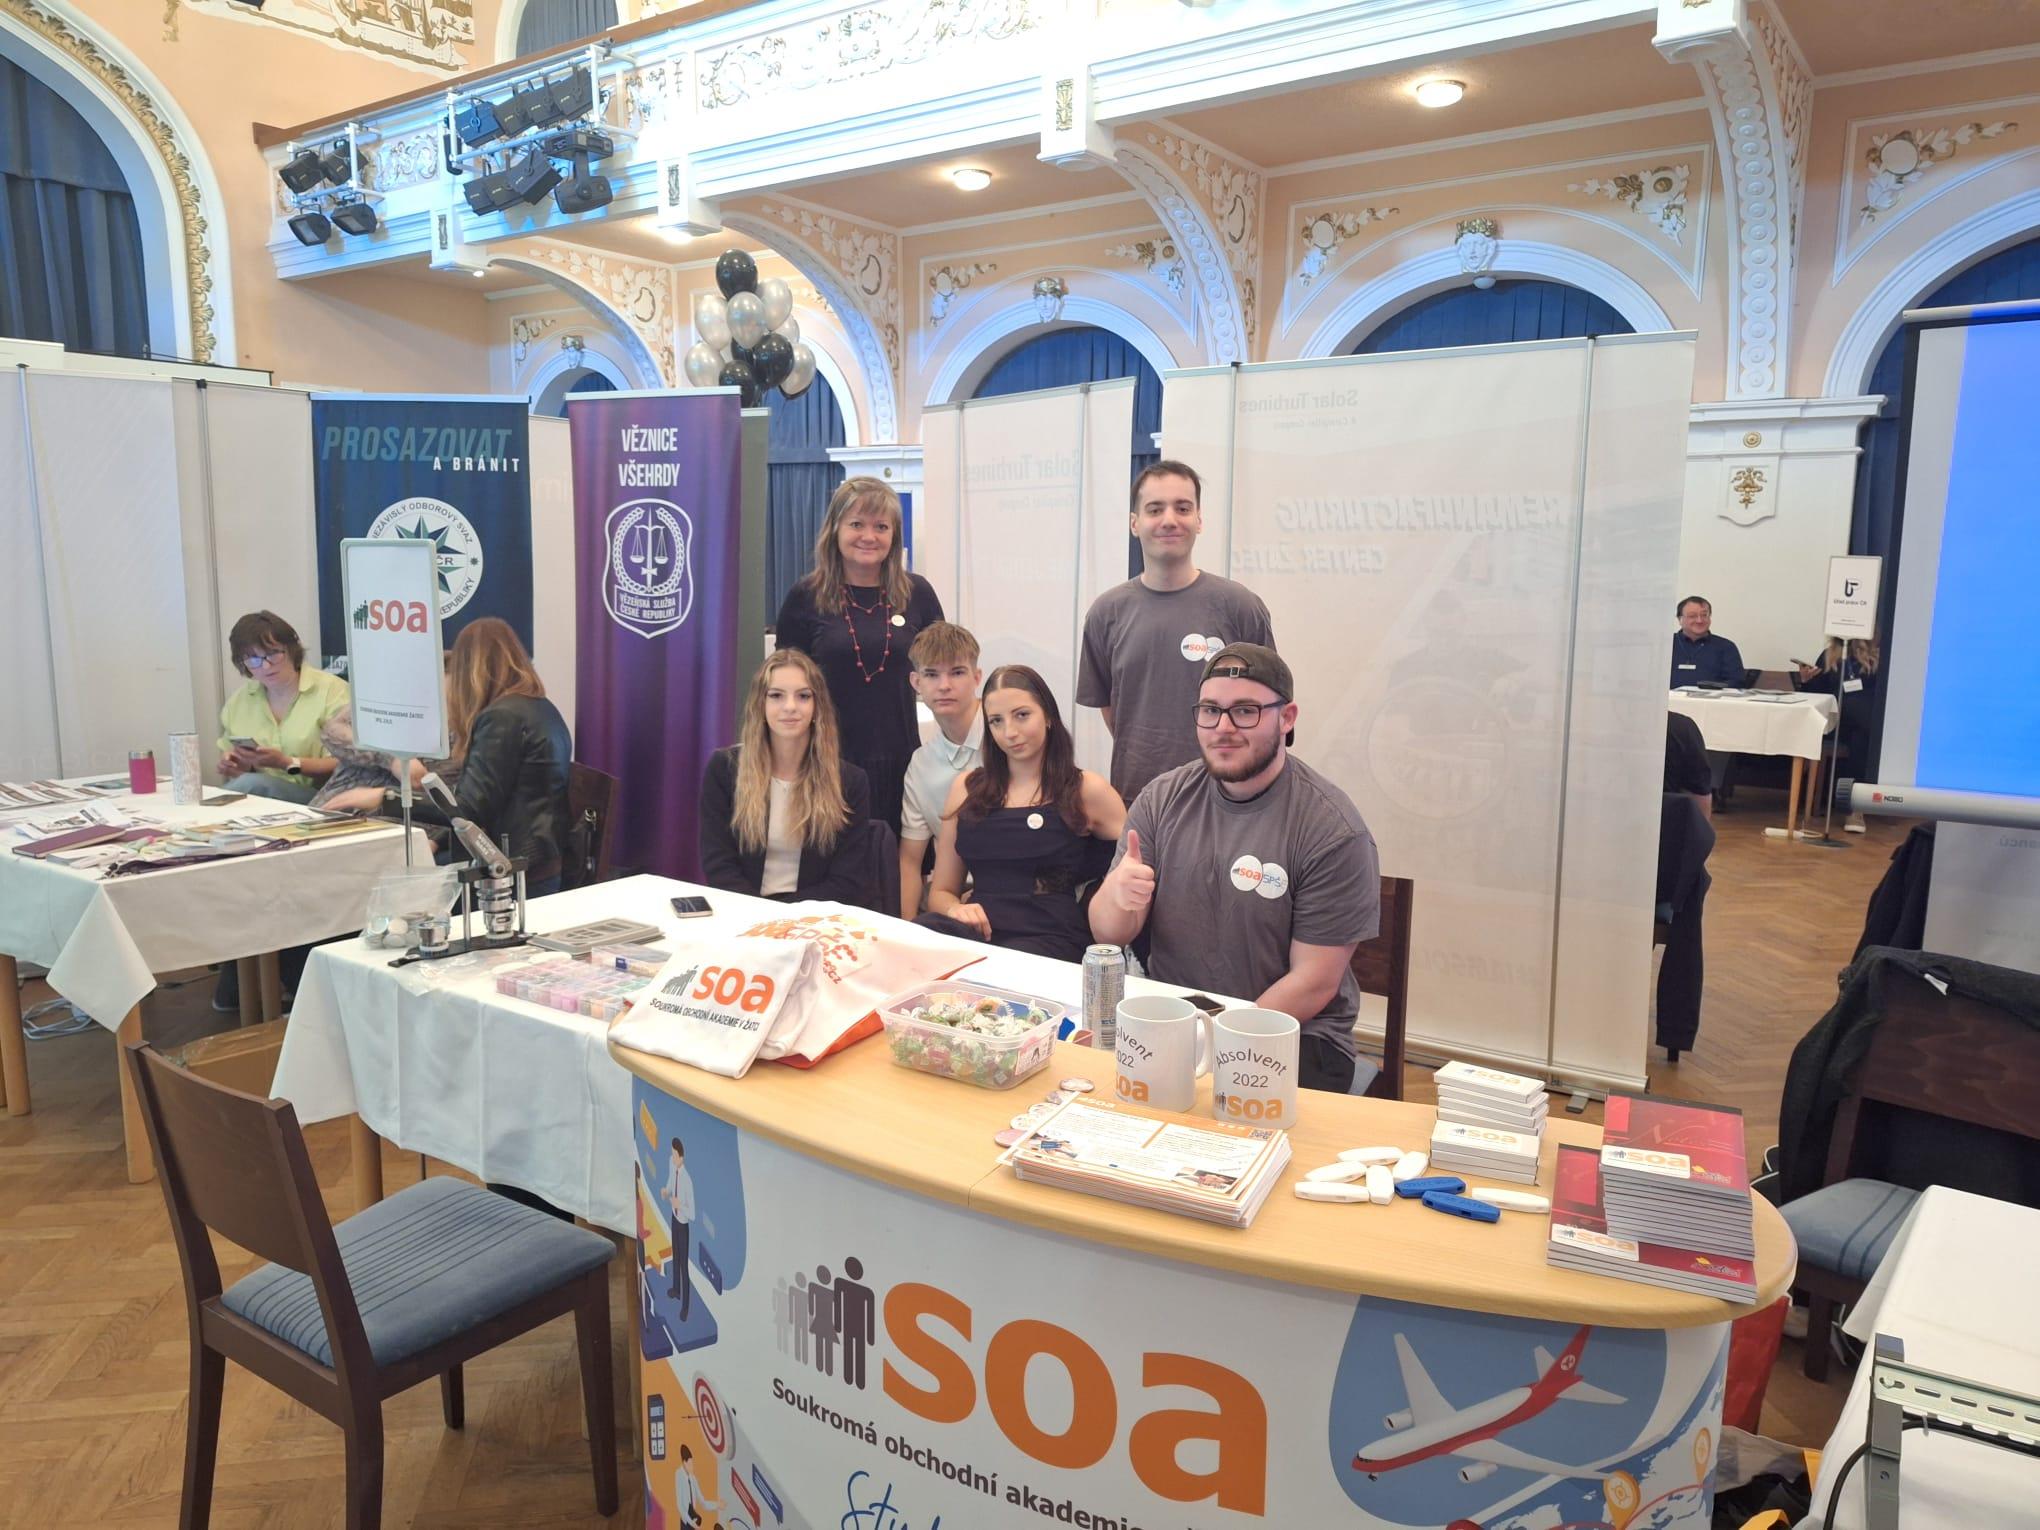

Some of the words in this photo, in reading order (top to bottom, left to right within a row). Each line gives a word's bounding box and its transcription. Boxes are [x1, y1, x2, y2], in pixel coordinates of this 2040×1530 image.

[322, 426, 513, 462] PROSAZOVAT
[621, 424, 678, 452] VĚZNICE
[433, 457, 442, 471] A
[452, 454, 520, 472] BRÁNIT
[618, 459, 680, 487] VŠEHRDY
[456, 521, 474, 545] SVAZ
[369, 599, 428, 634] soa
[1239, 867, 1262, 881] soa
[692, 964, 775, 1014] soa
[1215, 1048, 1288, 1077] Absolvent
[1117, 1075, 1149, 1103] oa
[1232, 1071, 1269, 1088] 2022
[1474, 1069, 1521, 1086] soa
[1226, 1095, 1283, 1121] soa
[1467, 1127, 1518, 1144] soa
[1626, 1150, 1688, 1168] soa
[1576, 1232, 1635, 1250] soa
[882, 1281, 1268, 1517] soa
[772, 1376, 879, 1446] Soukromá
[884, 1436, 998, 1497] obchodní
